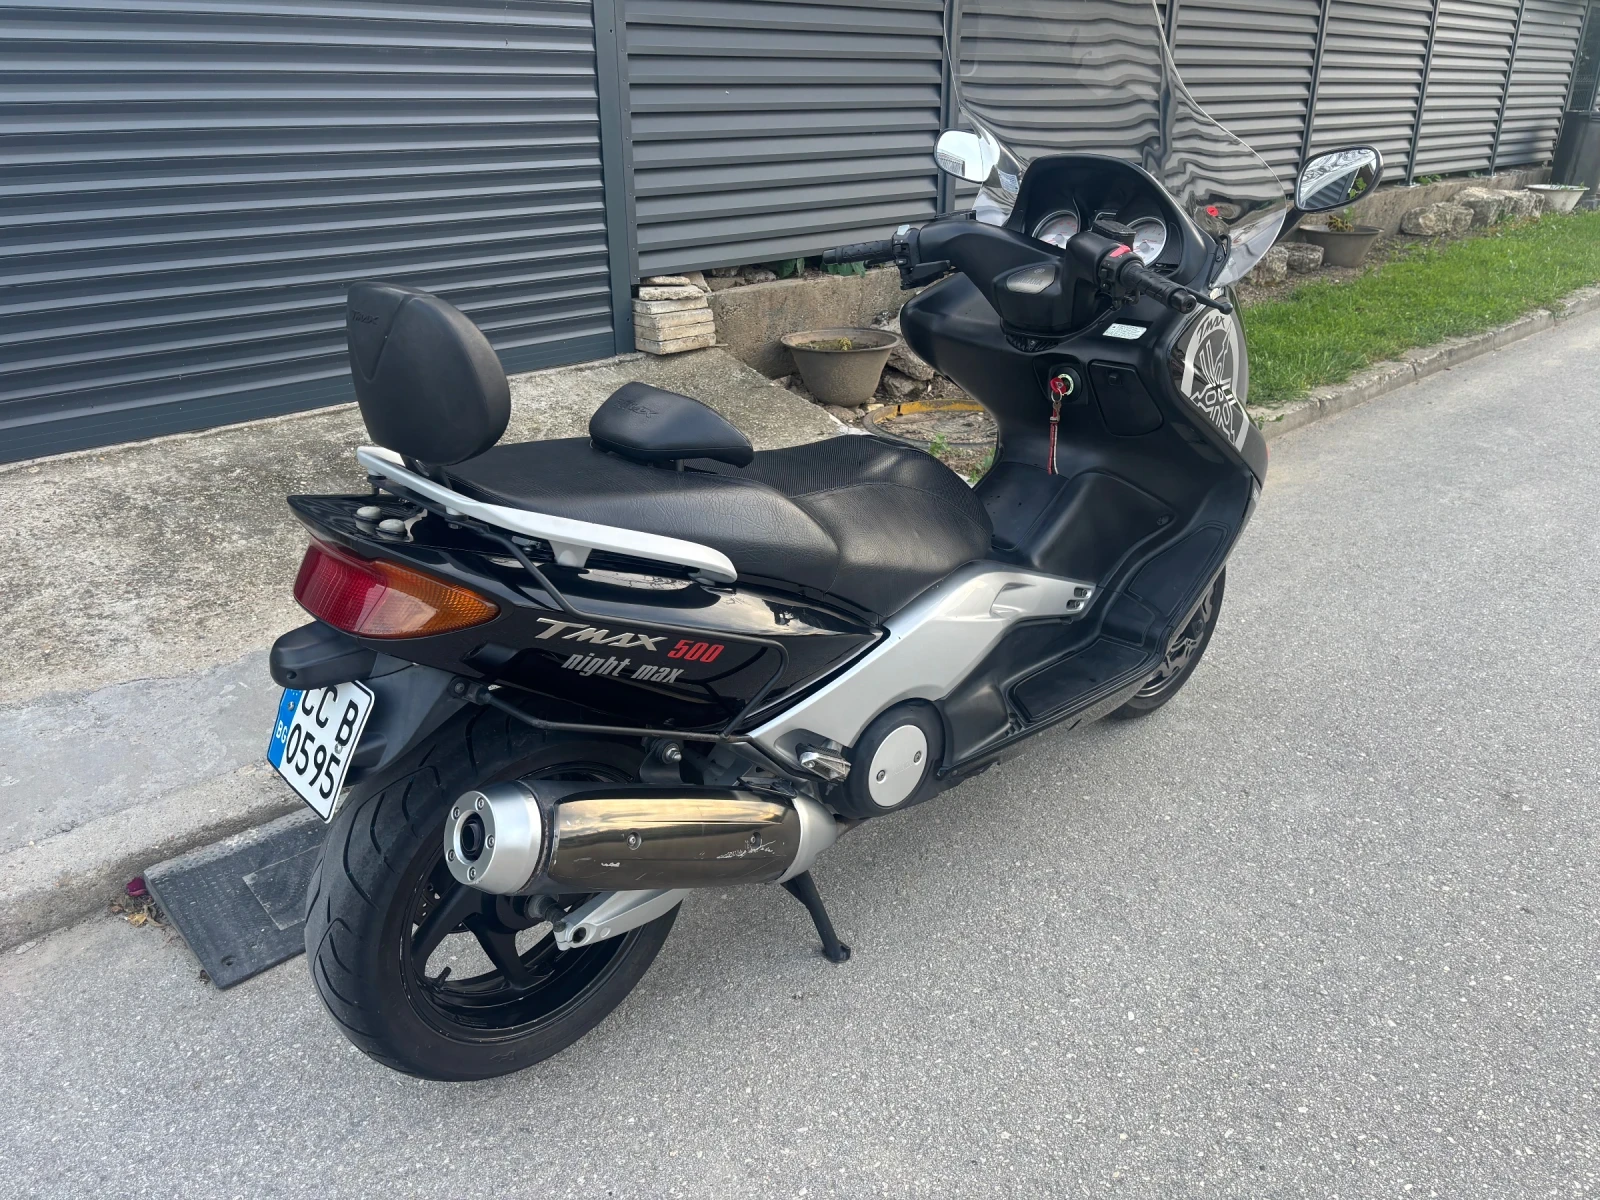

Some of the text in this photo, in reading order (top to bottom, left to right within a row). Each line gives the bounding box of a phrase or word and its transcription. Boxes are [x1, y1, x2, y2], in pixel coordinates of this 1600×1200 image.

[1197, 315, 1226, 341] TMAX
[534, 617, 725, 664] TMAX 500
[561, 653, 685, 684] night max
[275, 719, 288, 744] BG
[335, 699, 359, 747] B
[286, 723, 341, 799] 0595
